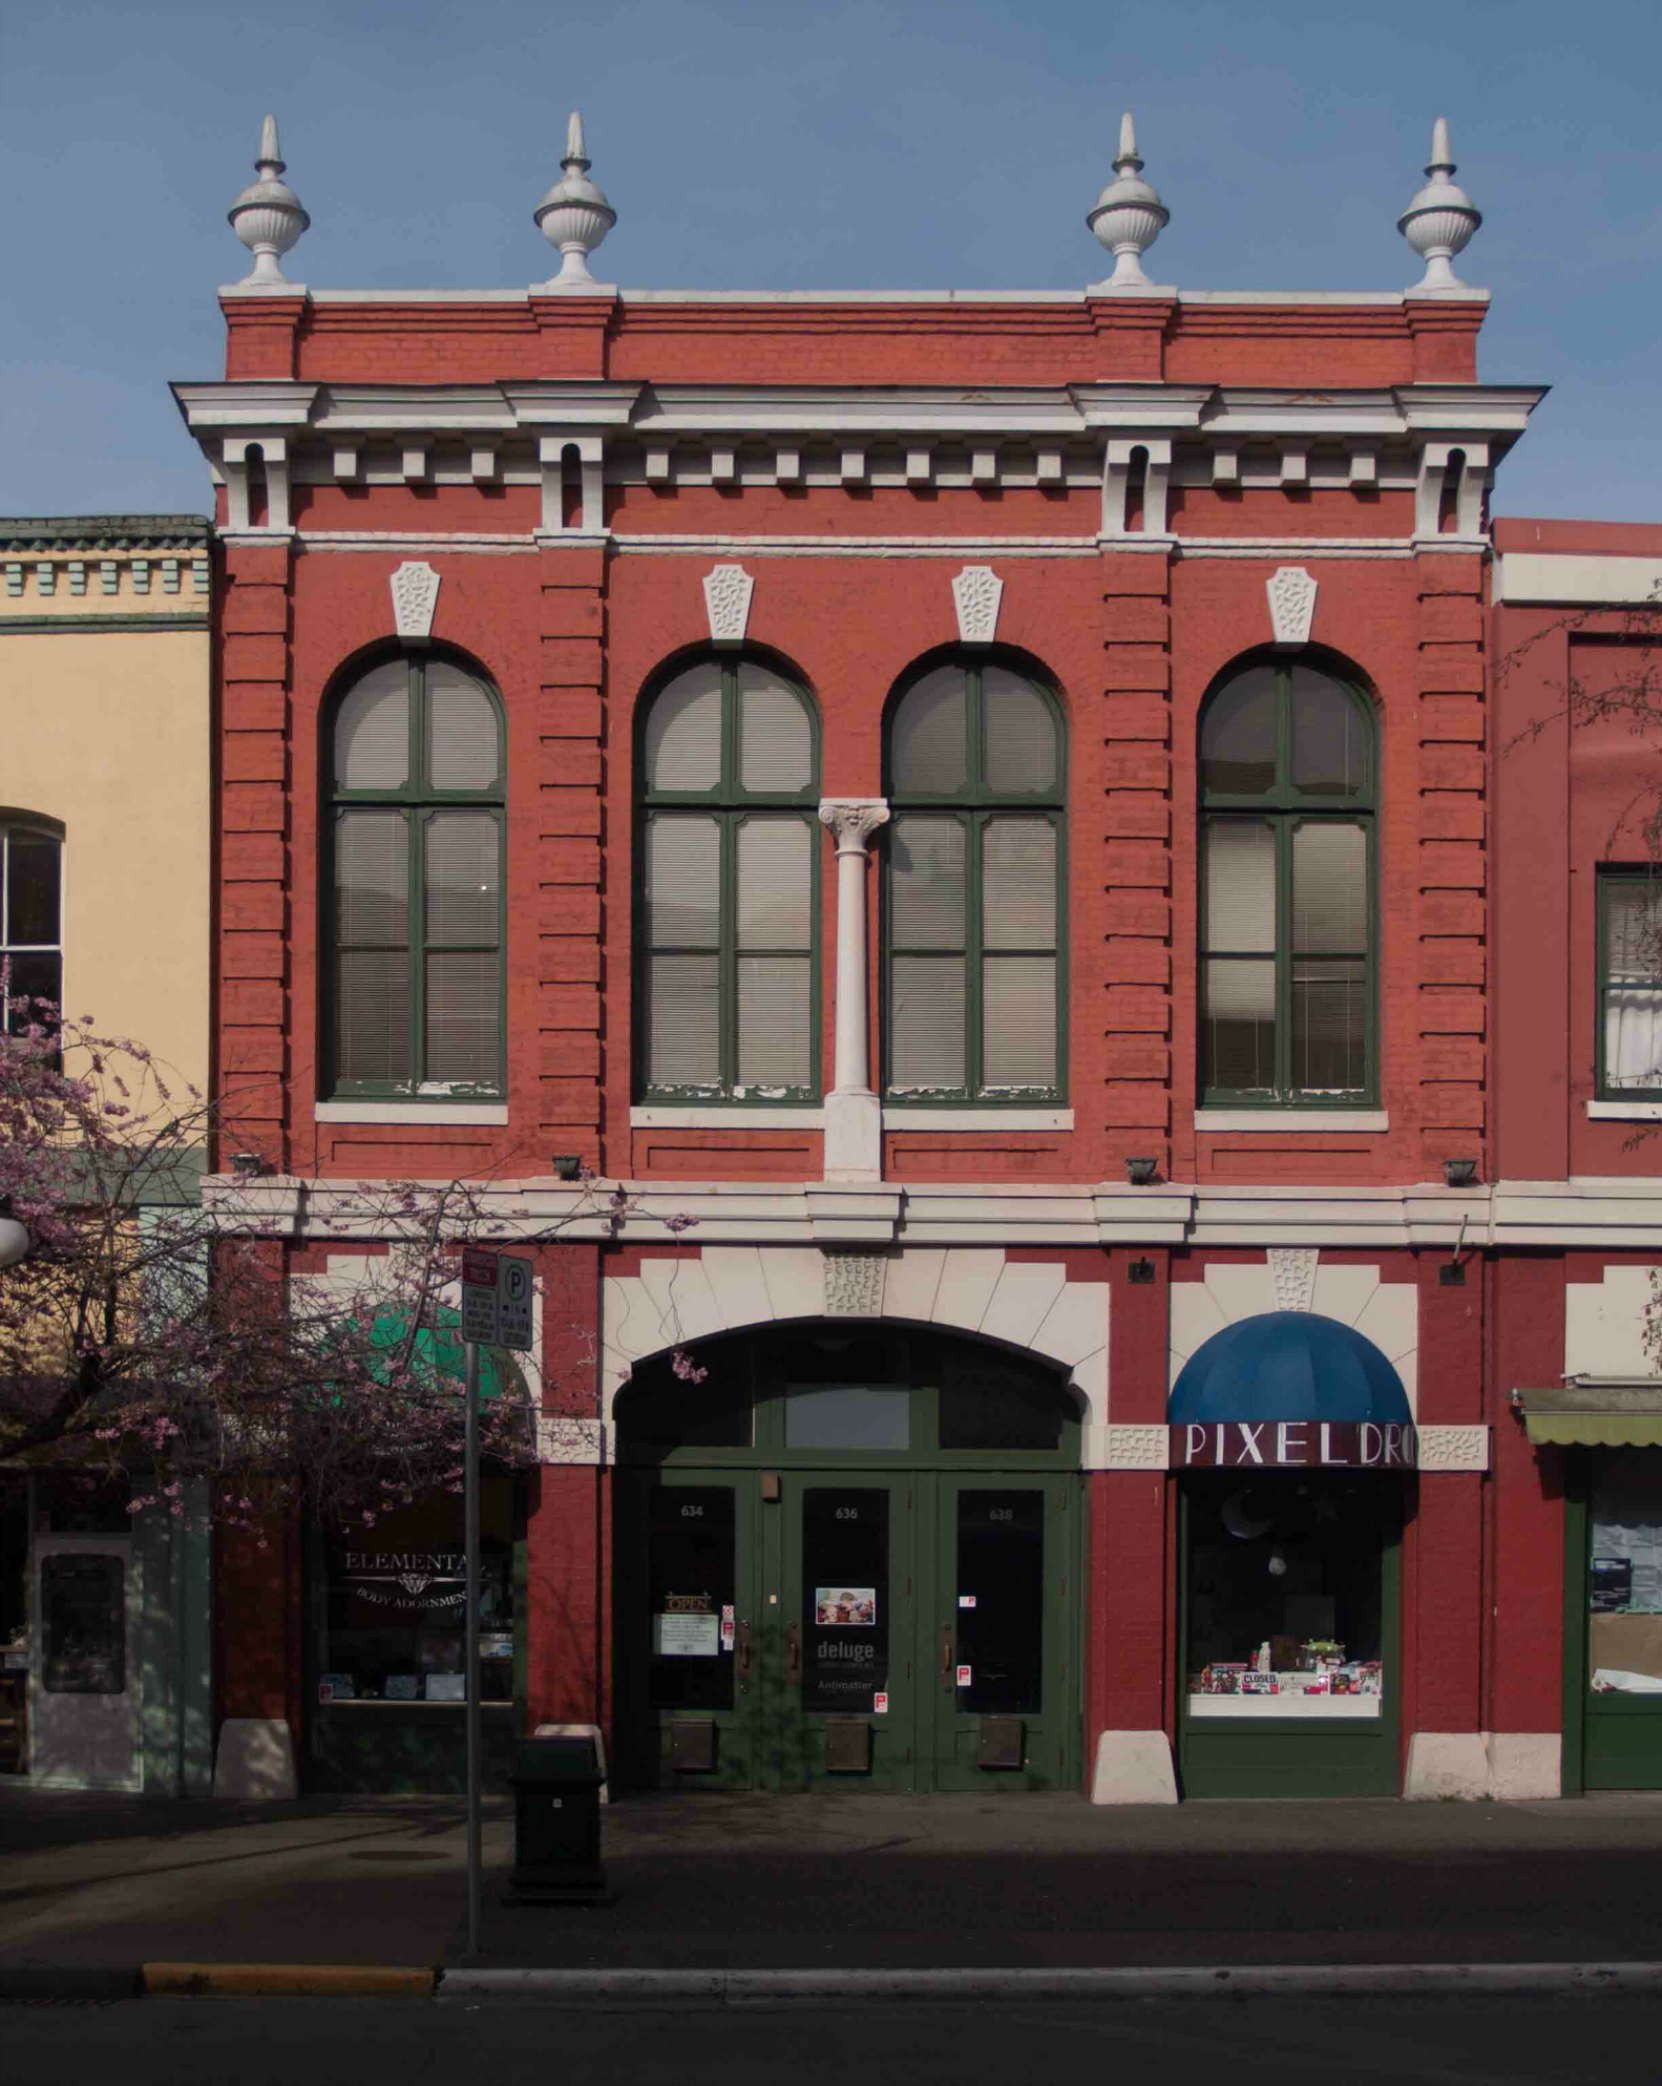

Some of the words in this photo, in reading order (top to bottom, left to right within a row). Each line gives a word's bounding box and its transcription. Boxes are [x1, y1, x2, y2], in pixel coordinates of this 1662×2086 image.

[511, 1271, 521, 1293] P
[1185, 1422, 1348, 1464] PIXEL
[680, 1504, 705, 1517] 634
[835, 1507, 858, 1520] 636
[345, 1551, 486, 1572] ELEMENTA
[356, 1585, 393, 1606] BODY
[393, 1590, 467, 1609] ADORNMEN
[669, 1598, 708, 1609] OPEN
[817, 1641, 875, 1662] deluge
[1243, 1674, 1276, 1683] CLOSED
